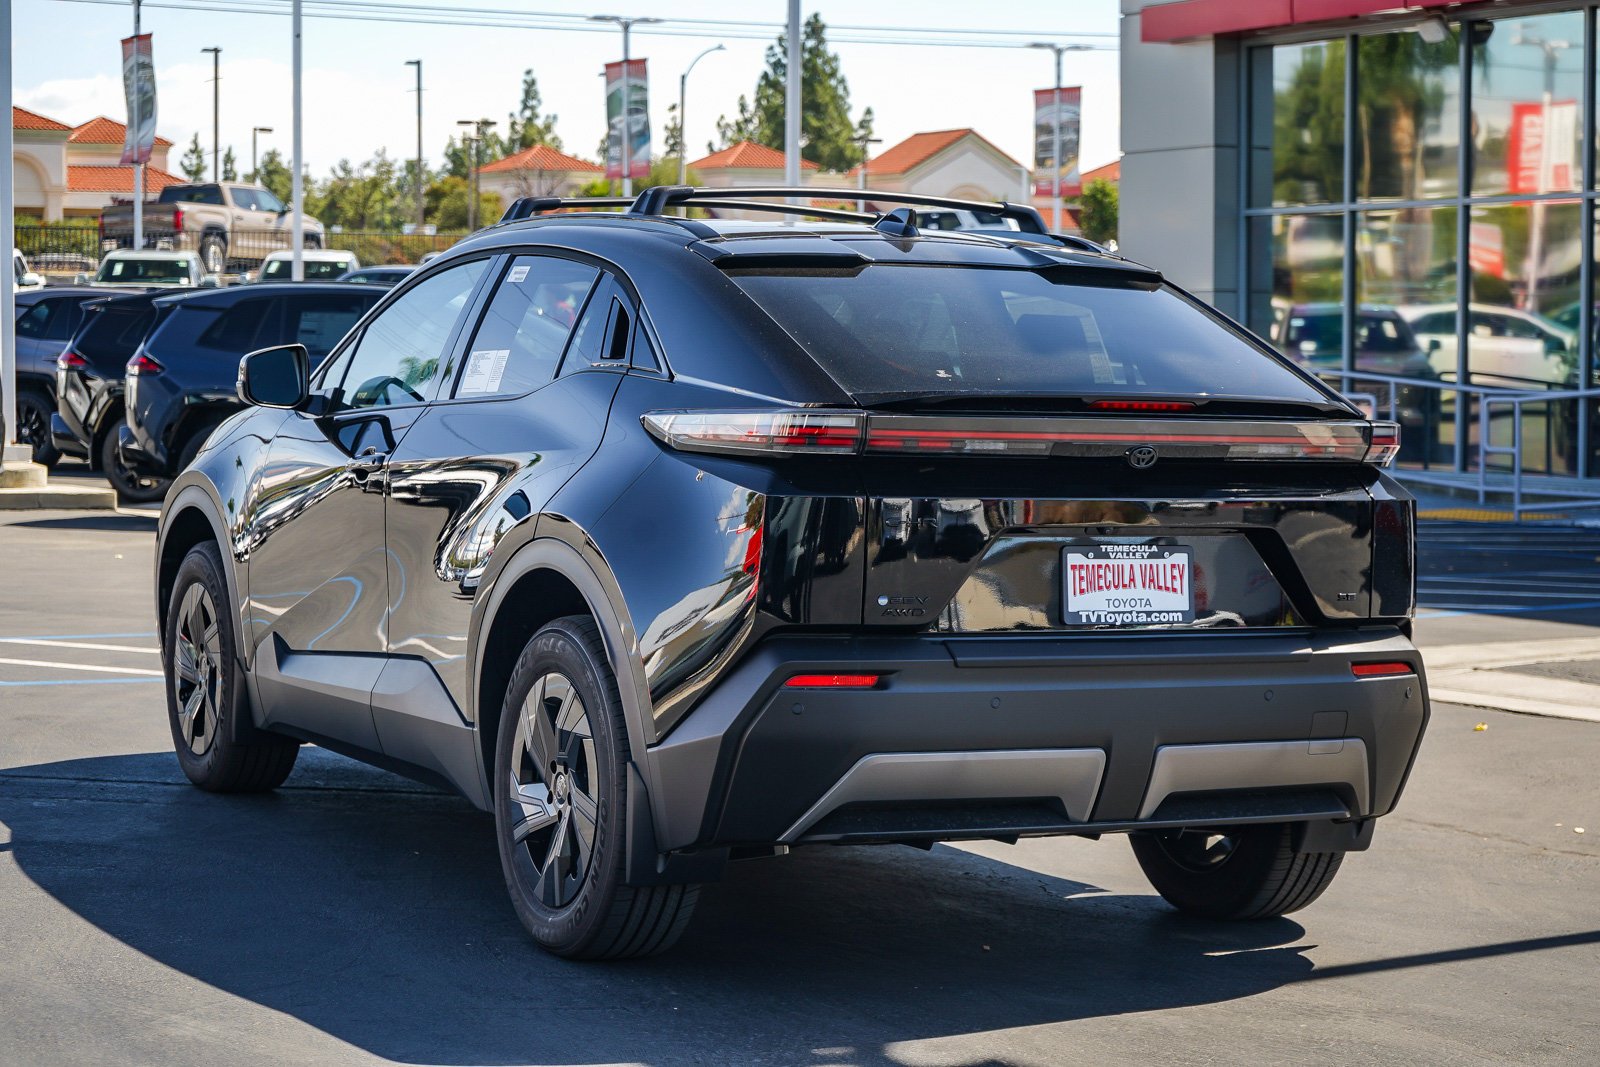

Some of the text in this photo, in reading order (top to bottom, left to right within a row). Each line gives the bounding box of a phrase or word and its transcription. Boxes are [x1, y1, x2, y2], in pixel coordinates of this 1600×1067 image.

[1070, 563, 1185, 597] TEMECULA VALLEY
[1105, 598, 1152, 608] TOYOTA
[880, 608, 926, 617] AWD
[1079, 611, 1183, 625] TVToyota.com
[590, 797, 609, 891] OPEN
